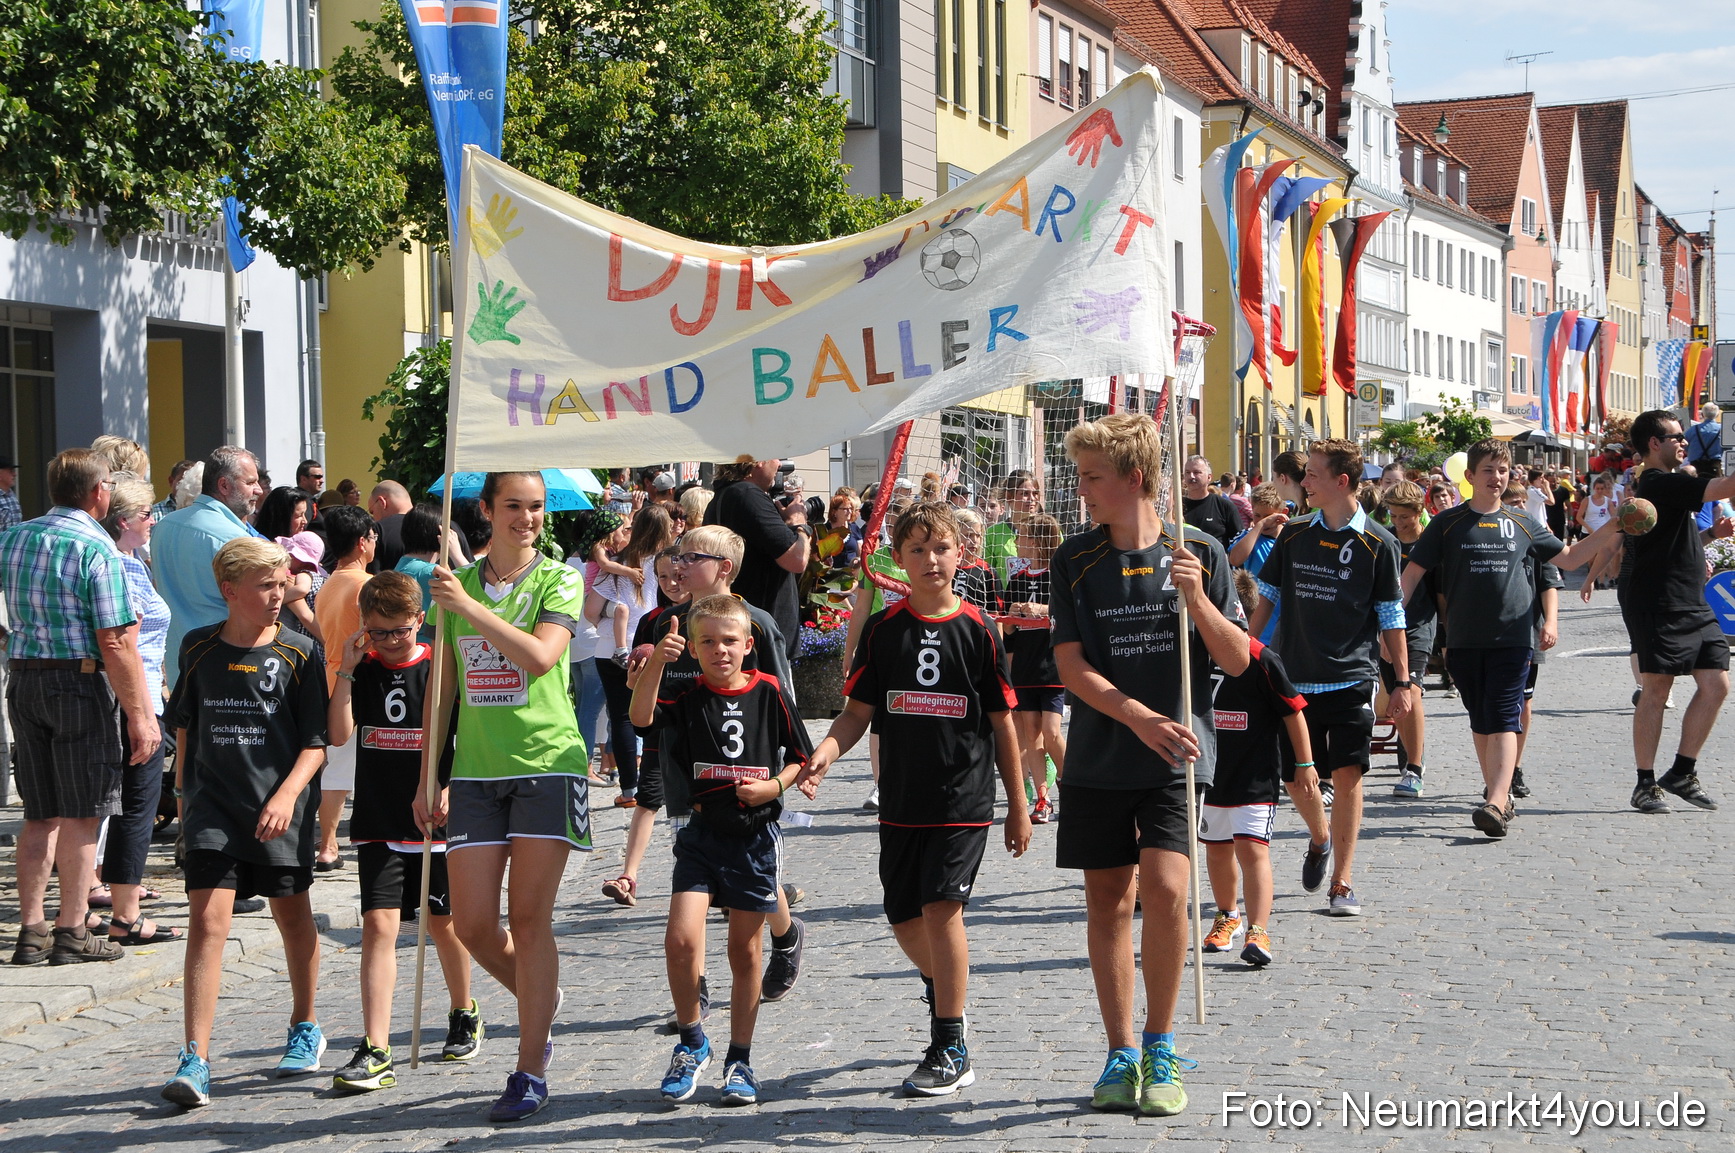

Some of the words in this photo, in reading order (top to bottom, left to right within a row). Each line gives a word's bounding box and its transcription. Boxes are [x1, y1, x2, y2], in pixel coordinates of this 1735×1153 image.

[230, 46, 252, 58] eG
[478, 89, 494, 100] eG
[607, 231, 798, 337] DJK
[506, 361, 705, 427] HAND
[752, 304, 1029, 406] BALLER
[1497, 518, 1515, 538] 10
[1339, 538, 1355, 565] 6
[1122, 567, 1154, 577] Kempa
[1292, 561, 1336, 575] HanseMerkur
[1295, 581, 1338, 594] Geschäftsstelle
[1314, 591, 1336, 601] Seidel
[512, 591, 534, 627] 2
[1095, 602, 1164, 618] HanseMerkur
[920, 638, 941, 646] erima
[1109, 630, 1175, 644] Geschäftsstelle
[1111, 645, 1143, 658] Jürgen
[1145, 641, 1175, 653] Seidel
[228, 663, 258, 673] Kempa
[916, 647, 940, 687] 8
[259, 657, 280, 692] 3
[467, 676, 519, 686] FRESSNAPF
[1210, 673, 1225, 705] 7
[203, 698, 260, 708] HanseMerkur
[384, 687, 407, 723] 6
[471, 694, 515, 703] NEUMARKT
[906, 694, 964, 707] Hundegitter24
[722, 709, 743, 717] erima
[210, 724, 267, 735] Geschäftsstelle
[378, 730, 423, 742] Hundegitter
[237, 735, 266, 746] Seidel
[721, 719, 744, 759] 3
